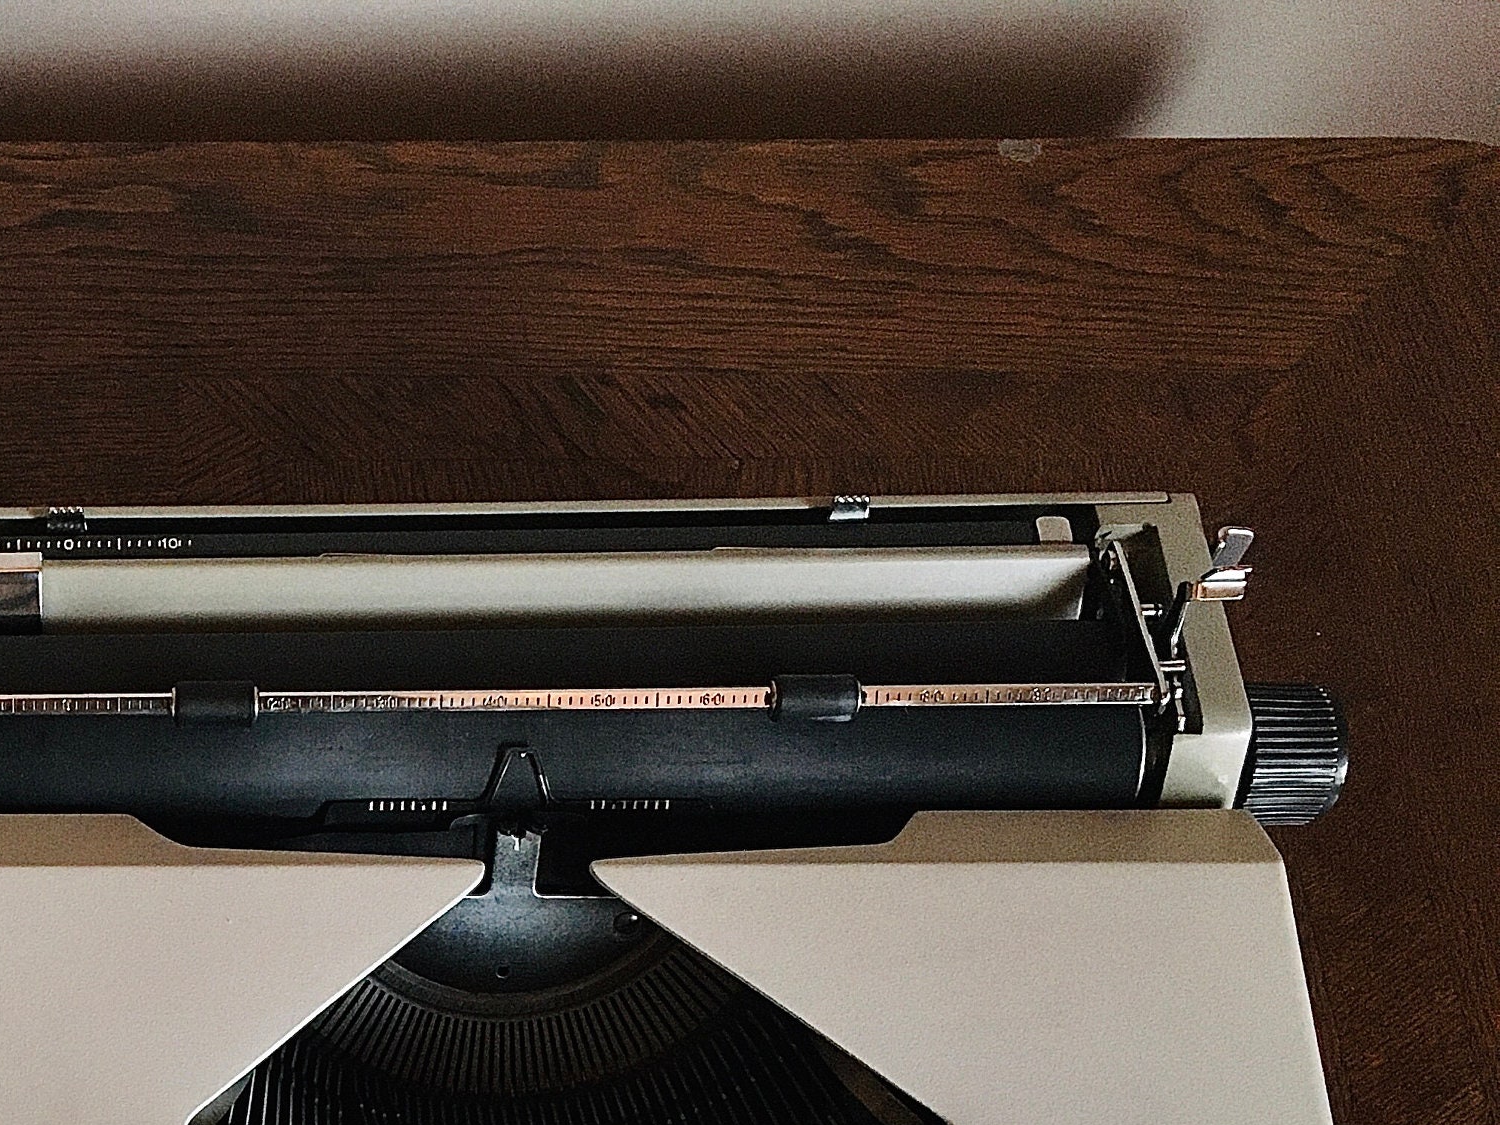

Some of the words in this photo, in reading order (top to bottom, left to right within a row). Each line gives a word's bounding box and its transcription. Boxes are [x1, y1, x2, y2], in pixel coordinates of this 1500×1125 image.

[162, 537, 178, 549] 10
[594, 694, 613, 707] 50
[702, 692, 721, 706] 60
